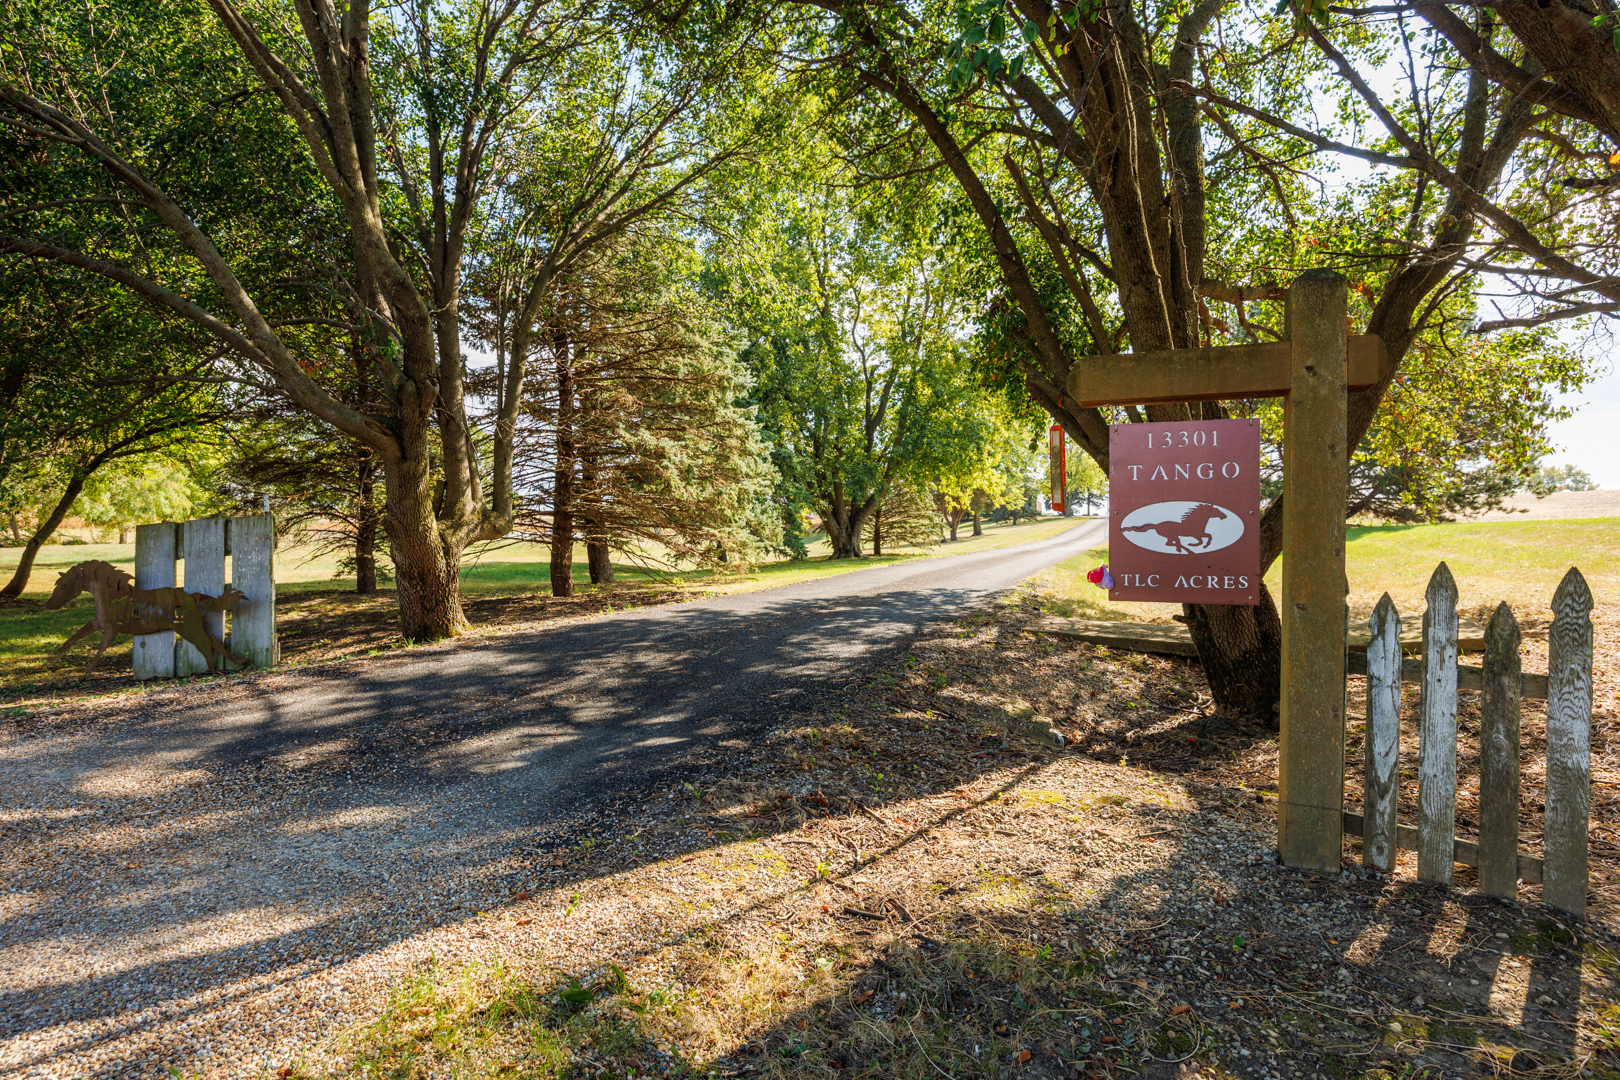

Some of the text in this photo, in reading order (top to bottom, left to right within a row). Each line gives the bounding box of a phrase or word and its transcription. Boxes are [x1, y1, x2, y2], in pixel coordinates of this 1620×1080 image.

[1146, 430, 1219, 449] 13301
[1127, 461, 1240, 481] TANGO
[1120, 573, 1249, 589] TLC ACRES
